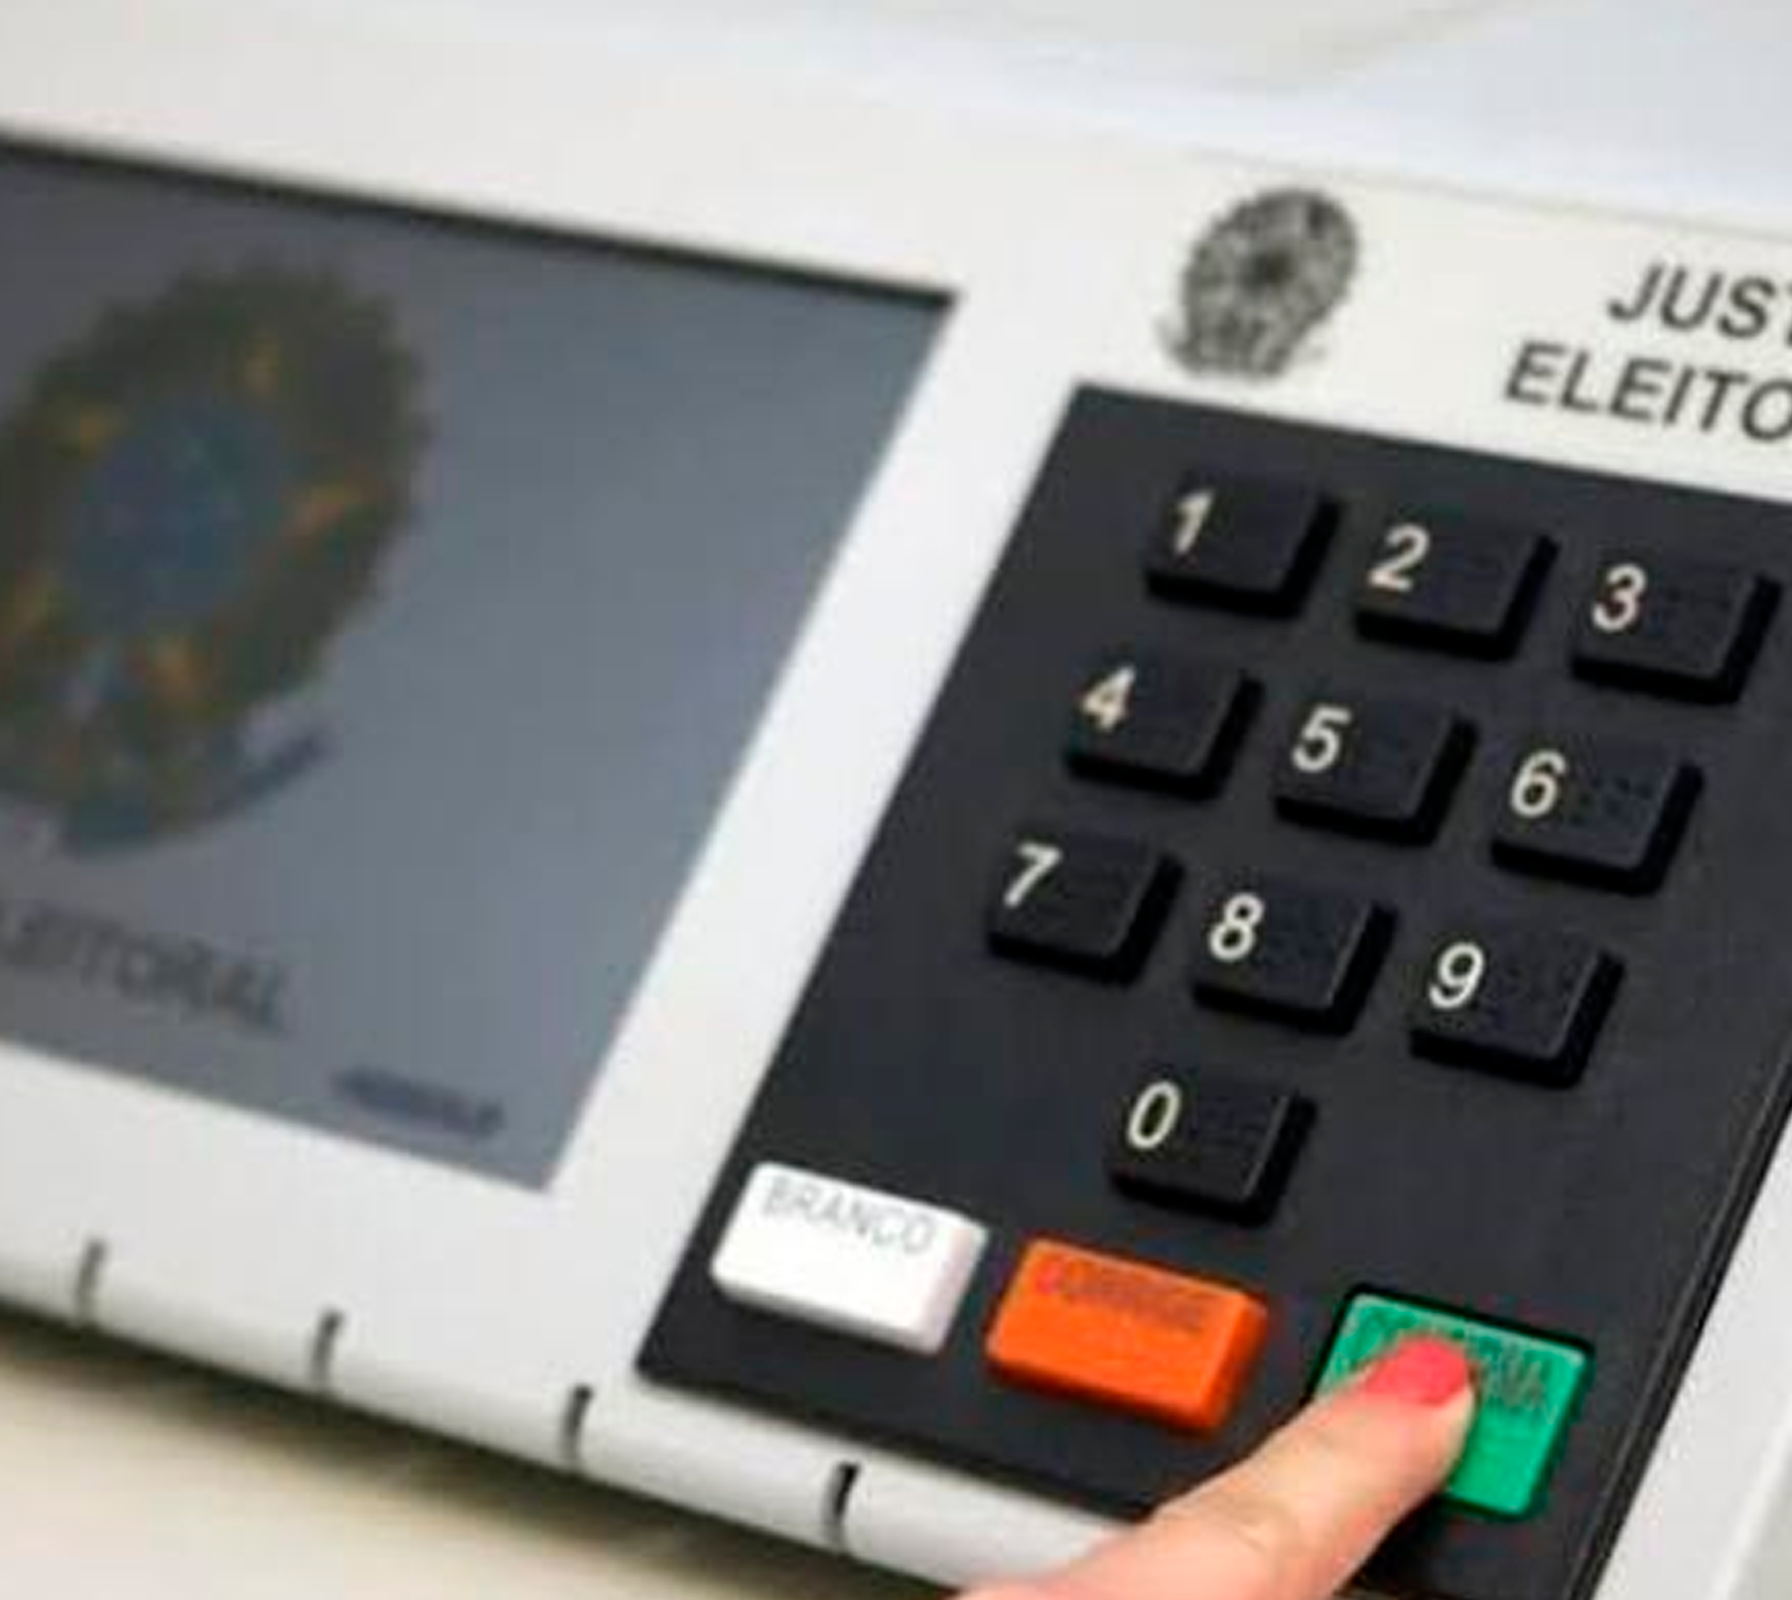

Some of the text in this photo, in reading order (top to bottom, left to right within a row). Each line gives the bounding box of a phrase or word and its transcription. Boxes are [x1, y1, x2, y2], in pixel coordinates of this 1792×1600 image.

[1504, 341, 1792, 444] ELEITO
[1177, 493, 1211, 551] 1
[1370, 525, 1428, 590] 2
[1593, 565, 1645, 630] 3
[1083, 668, 1134, 728] 4
[1293, 706, 1349, 772] 5
[1511, 751, 1565, 817] 6
[1005, 844, 1060, 906] 7
[1210, 893, 1264, 960] 8
[1429, 943, 1484, 1009] 9
[1128, 1082, 1179, 1148] 0
[762, 1174, 936, 1255] BRANCO
